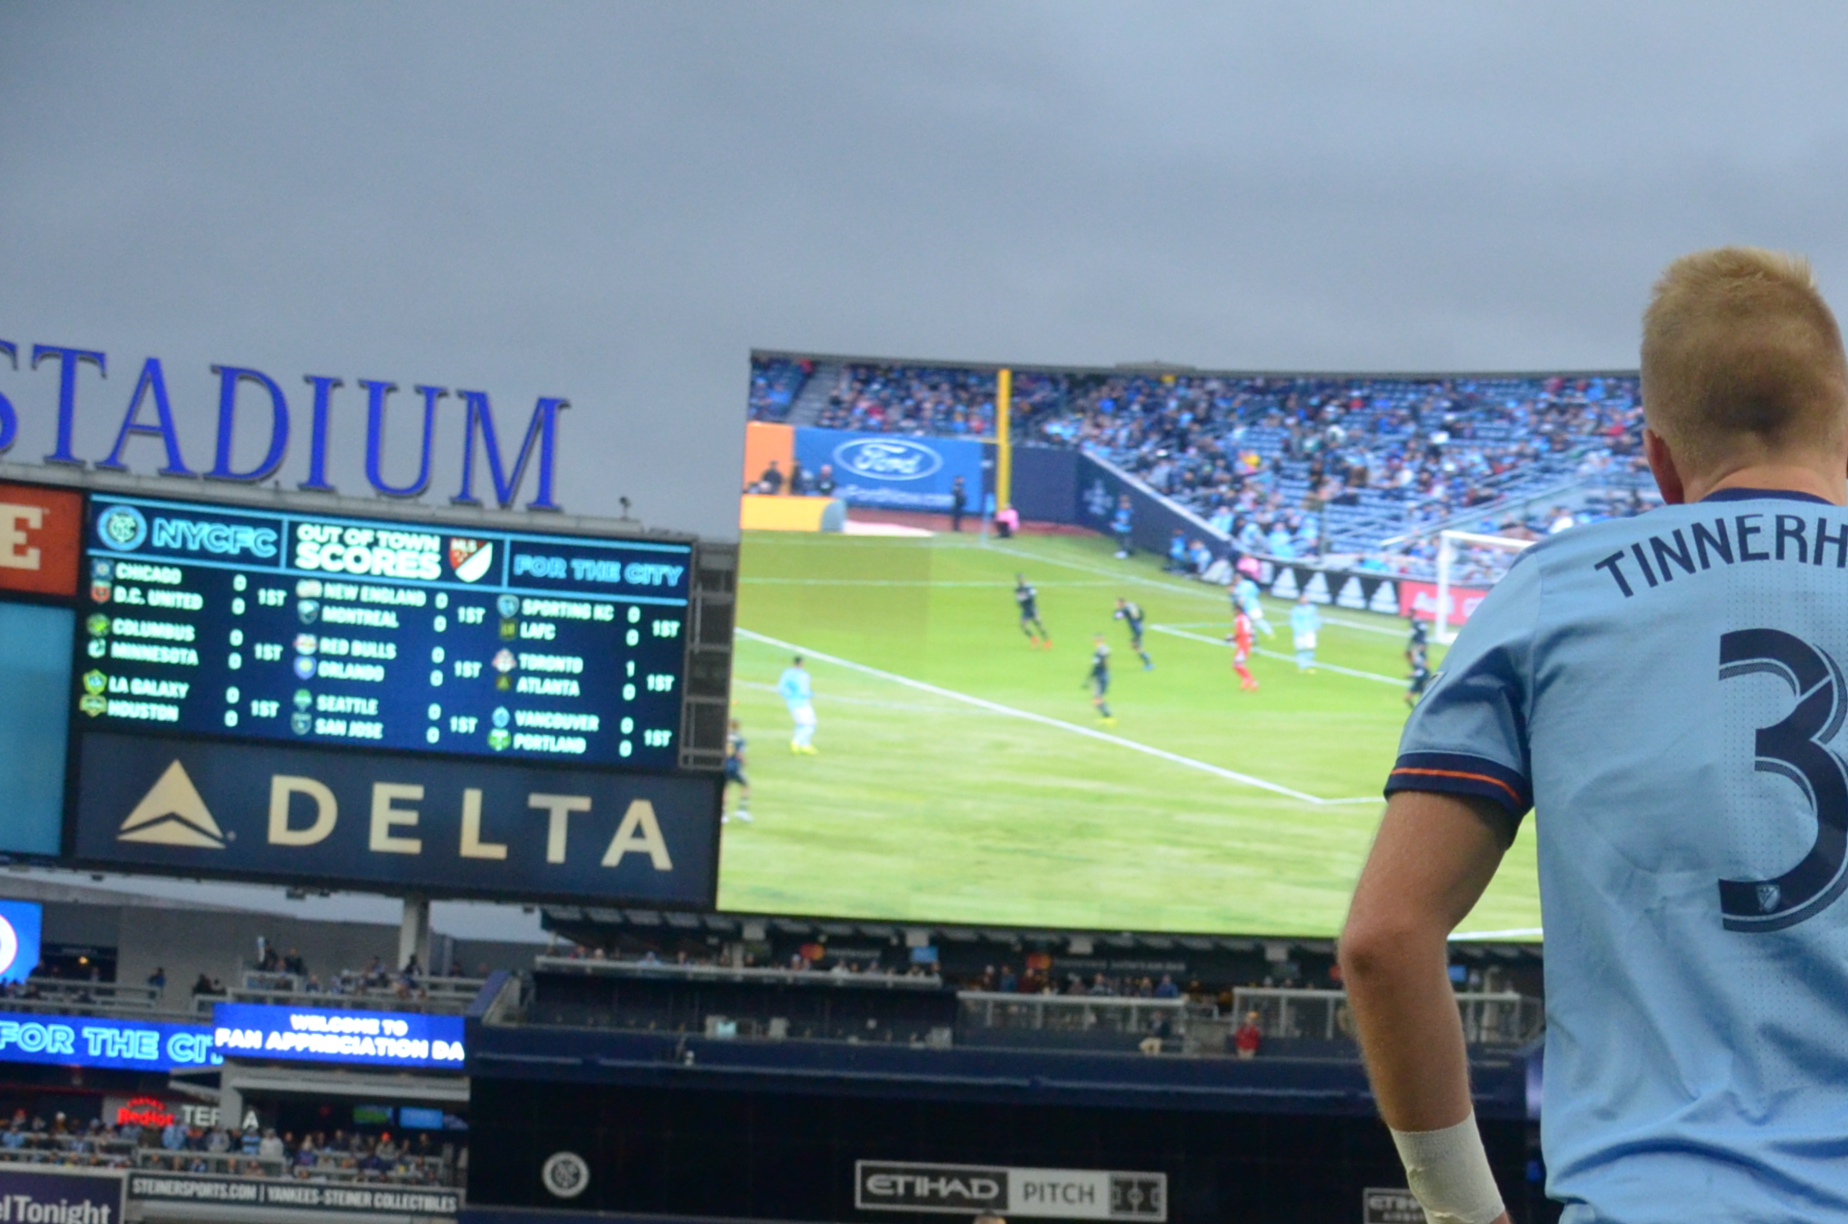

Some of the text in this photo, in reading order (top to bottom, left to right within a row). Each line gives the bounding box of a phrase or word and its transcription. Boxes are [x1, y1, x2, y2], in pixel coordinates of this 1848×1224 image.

[853, 444, 922, 473] Ford
[153, 517, 278, 558] NYCFC
[296, 523, 440, 552] OUT OF TOWN
[295, 541, 442, 580] SCORES
[514, 554, 684, 587] FOR THE CITY
[115, 562, 247, 592] CHICAGO 0
[114, 586, 246, 615] D.C. UNITED 0
[258, 588, 287, 607] 1ST
[323, 582, 448, 609] NEW ENGLAND 0
[322, 606, 447, 633] MONTREAL 0
[457, 606, 486, 624] 1ST
[522, 599, 641, 623] SPORTING KC 0
[112, 618, 244, 647] COLUMBUS 0
[520, 622, 639, 646] LAFC 0
[652, 620, 680, 637] 1ST
[111, 642, 242, 669] MINNESOTA 0
[254, 643, 283, 661] 1ST
[319, 637, 445, 664] RED BULLS 0
[317, 660, 444, 687] ORLANDO 0
[454, 661, 482, 678] 1ST
[518, 653, 635, 677] TORONTO 1
[108, 676, 240, 704] LA GALAXY 0
[516, 676, 636, 701] ATLANTA 0
[647, 674, 675, 692] 1ST
[107, 700, 238, 727] HOUSTON 0
[251, 700, 280, 718] 1ST
[316, 694, 441, 721] SEATTLE 0
[314, 717, 440, 744] SAN JOSE 0
[450, 716, 478, 734] 1ST
[514, 710, 634, 734] VANCOUVER 0
[513, 733, 632, 758] PORTLAND 0
[644, 729, 672, 747] 1ST
[267, 775, 673, 871] DELTA
[290, 1013, 408, 1036] WELCOME TO
[0, 1020, 75, 1054] FOR
[82, 1027, 160, 1060] THE
[215, 1027, 465, 1061] FAN APPRECIATION DA
[133, 1177, 257, 1200] STEINERSPORTS.COM
[374, 1192, 457, 1213] COLLECTIBLES
[866, 1173, 1095, 1205] ETIHAD PITCH
